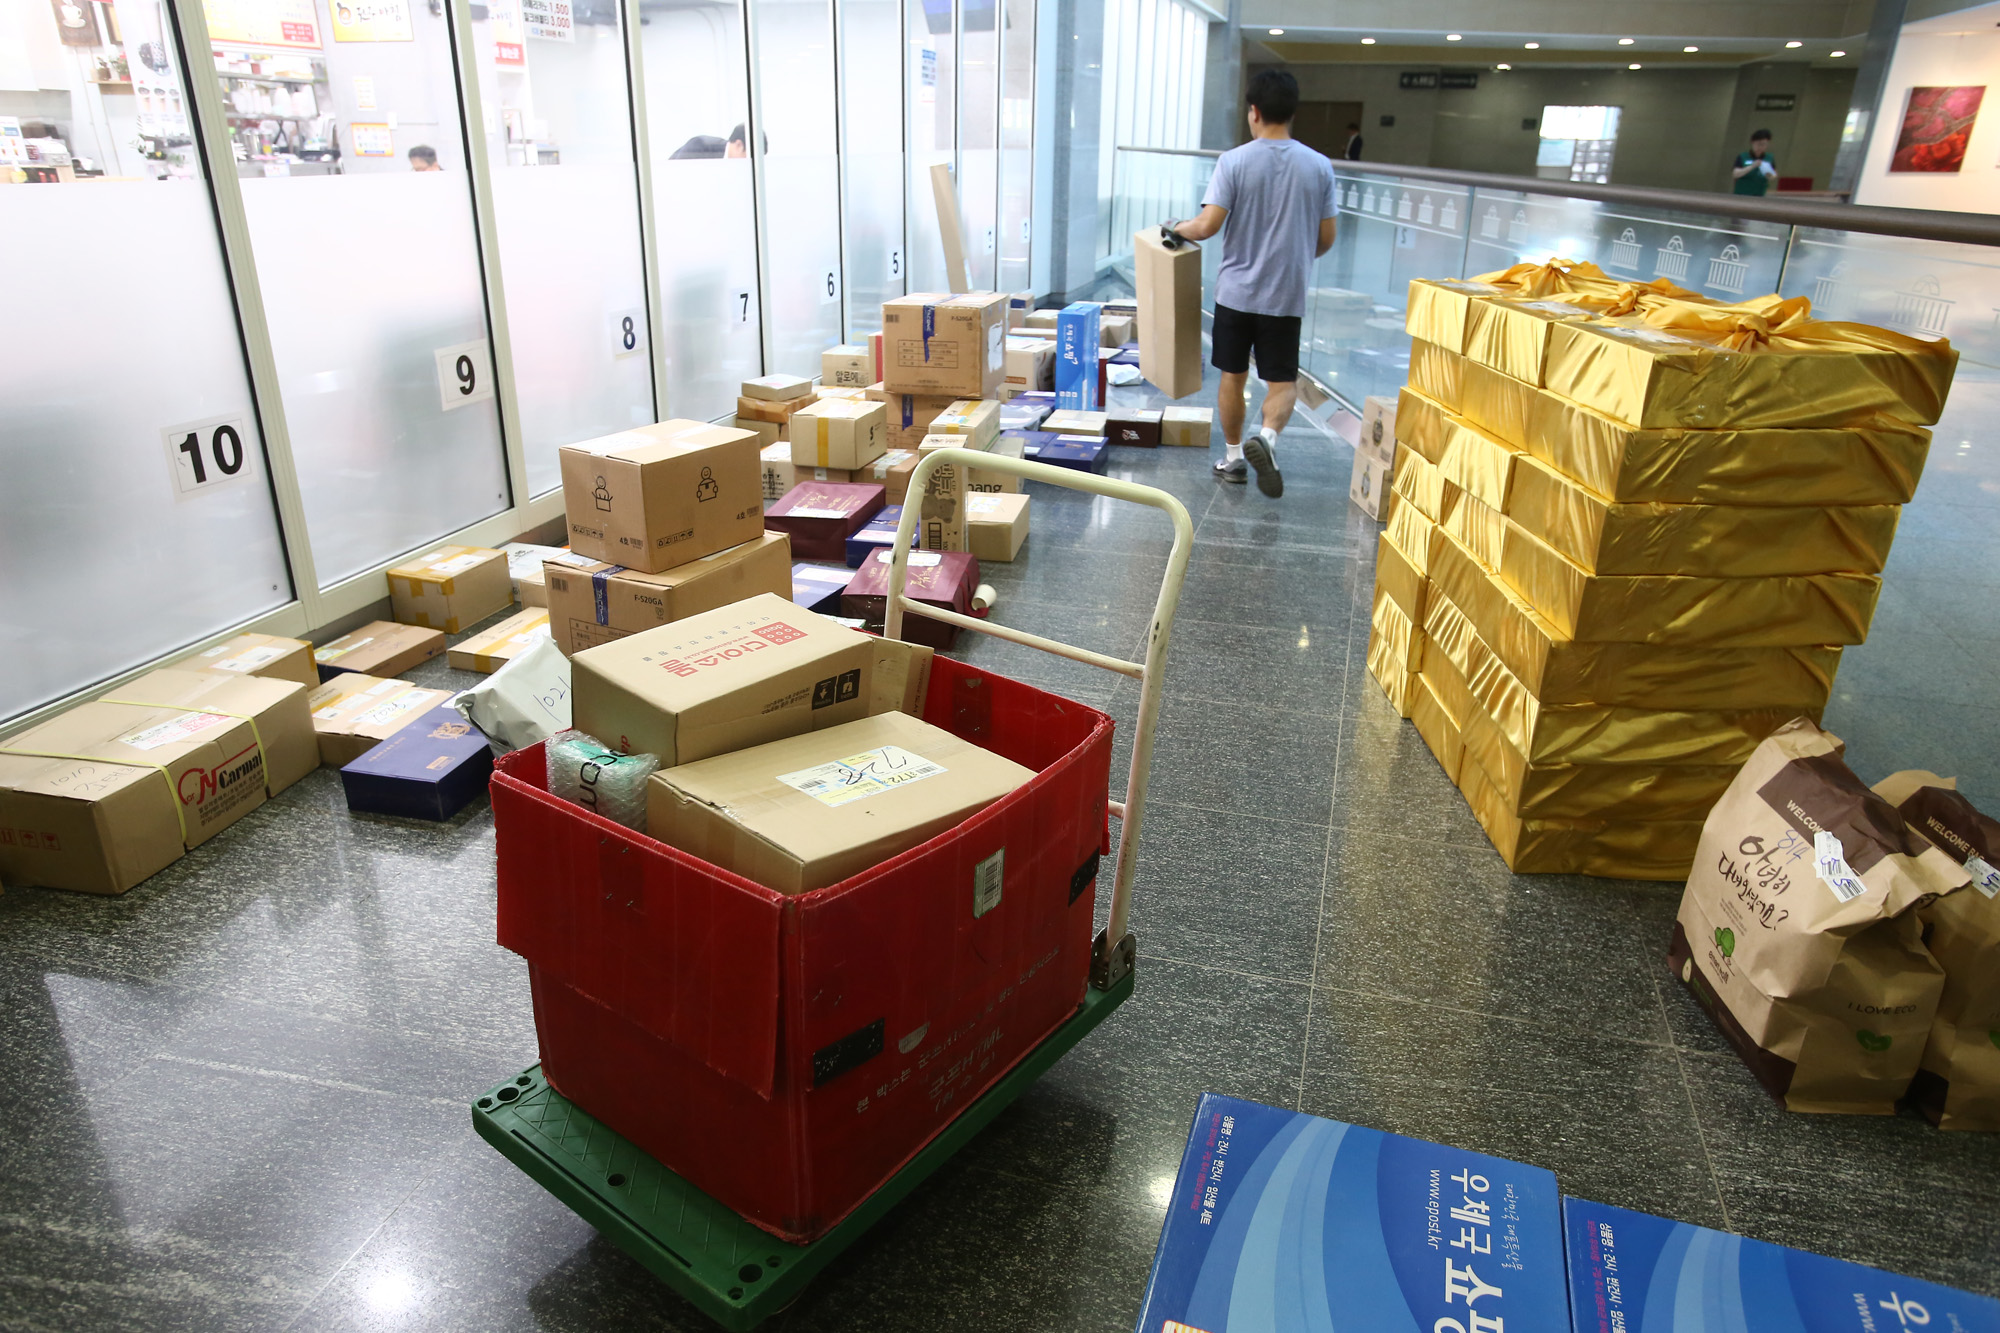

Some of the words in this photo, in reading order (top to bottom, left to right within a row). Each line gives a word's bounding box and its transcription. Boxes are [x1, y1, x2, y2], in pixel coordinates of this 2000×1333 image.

[893, 252, 898, 274] 5
[827, 272, 835, 297] 6
[739, 293, 749, 322] 7
[621, 316, 635, 350] 8
[455, 354, 476, 396] 9
[179, 425, 243, 483] 10
[736, 511, 746, 521] 4호
[619, 536, 629, 546] 4호
[758, 624, 784, 635] daiso
[658, 640, 769, 678] 다이소몰
[1786, 800, 1823, 833] WELCOM
[1927, 816, 1970, 853] WELCOME
[1856, 1004, 1892, 1015] LOVE
[1893, 1004, 1917, 1014] ECO
[1221, 1115, 1235, 1136] 상품명
[1216, 1140, 1229, 1156] 건시
[1209, 1159, 1225, 1182] 반건시
[1203, 1186, 1219, 1209] 임산물
[1425, 1169, 1442, 1250] www.epost.kr
[1200, 1209, 1213, 1226] 세트
[1450, 1168, 1492, 1255] 우체국
[1600, 1222, 1615, 1248] 상품명
[1603, 1253, 1618, 1272] 건시
[1606, 1276, 1622, 1304] 반건시
